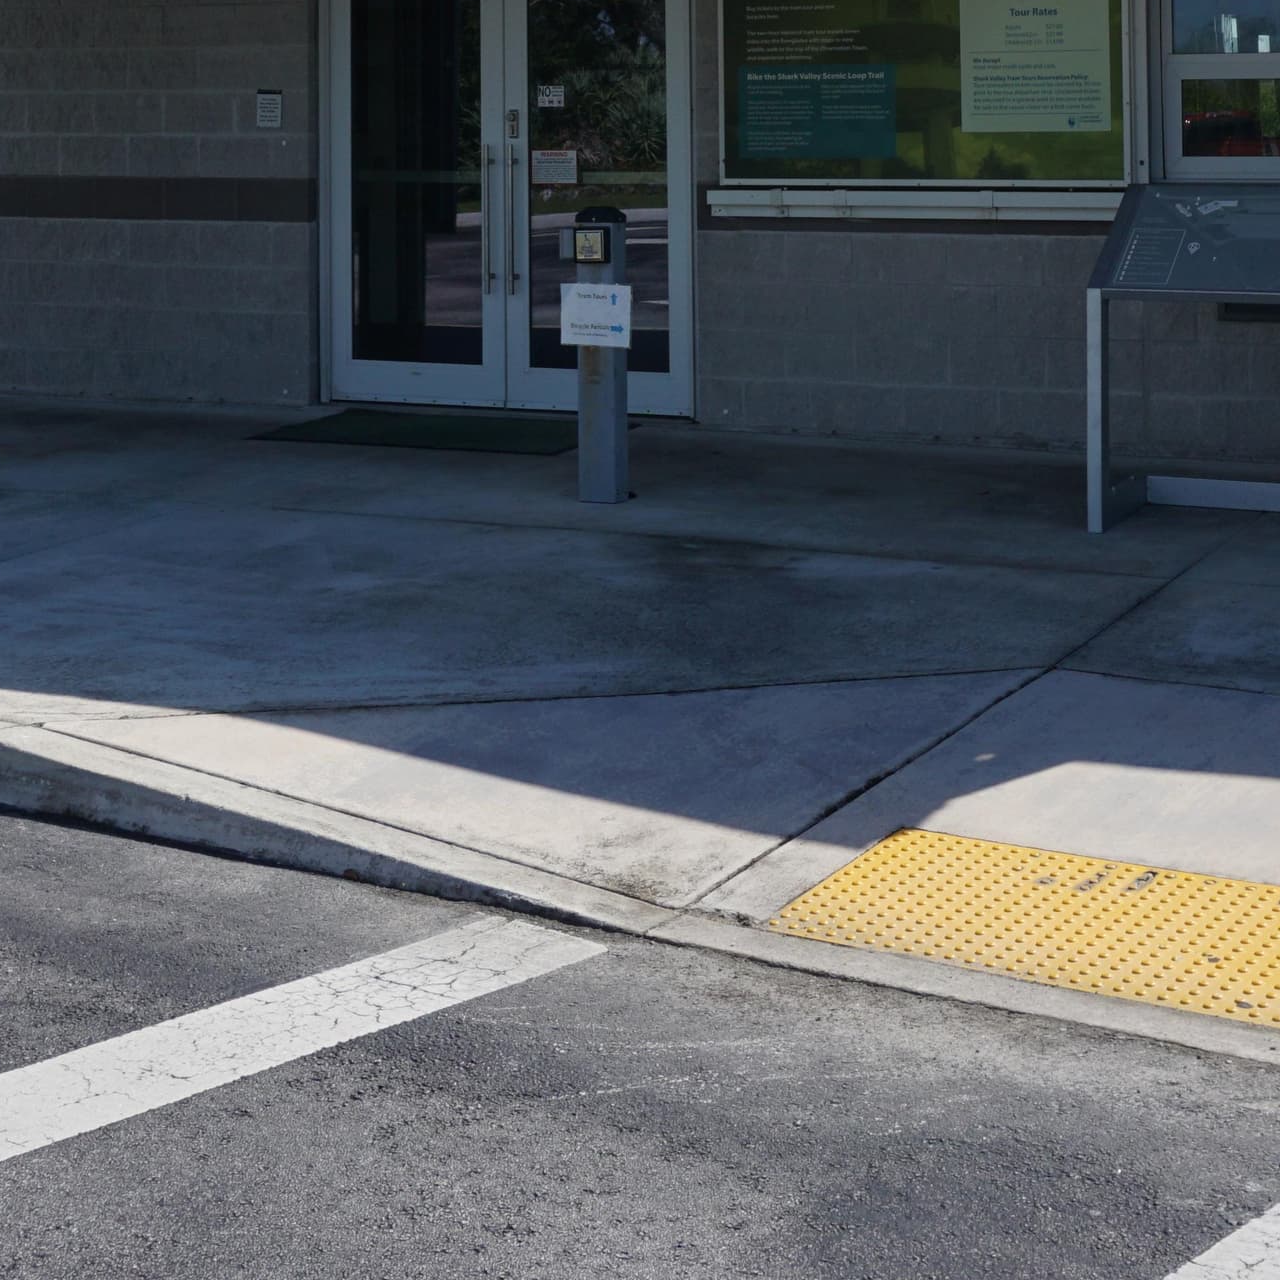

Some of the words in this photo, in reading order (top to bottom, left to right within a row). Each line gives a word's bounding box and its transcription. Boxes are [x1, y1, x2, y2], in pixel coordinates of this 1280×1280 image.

[1009, 7, 1030, 17] Tour
[1032, 7, 1058, 17] Rates
[747, 73, 763, 81] Bike
[777, 72, 799, 80] Shark
[799, 72, 821, 81] Valley
[822, 72, 847, 80] Scenic
[848, 72, 867, 81] Loop
[868, 71, 885, 79] Trail
[538, 86, 551, 97] NO
